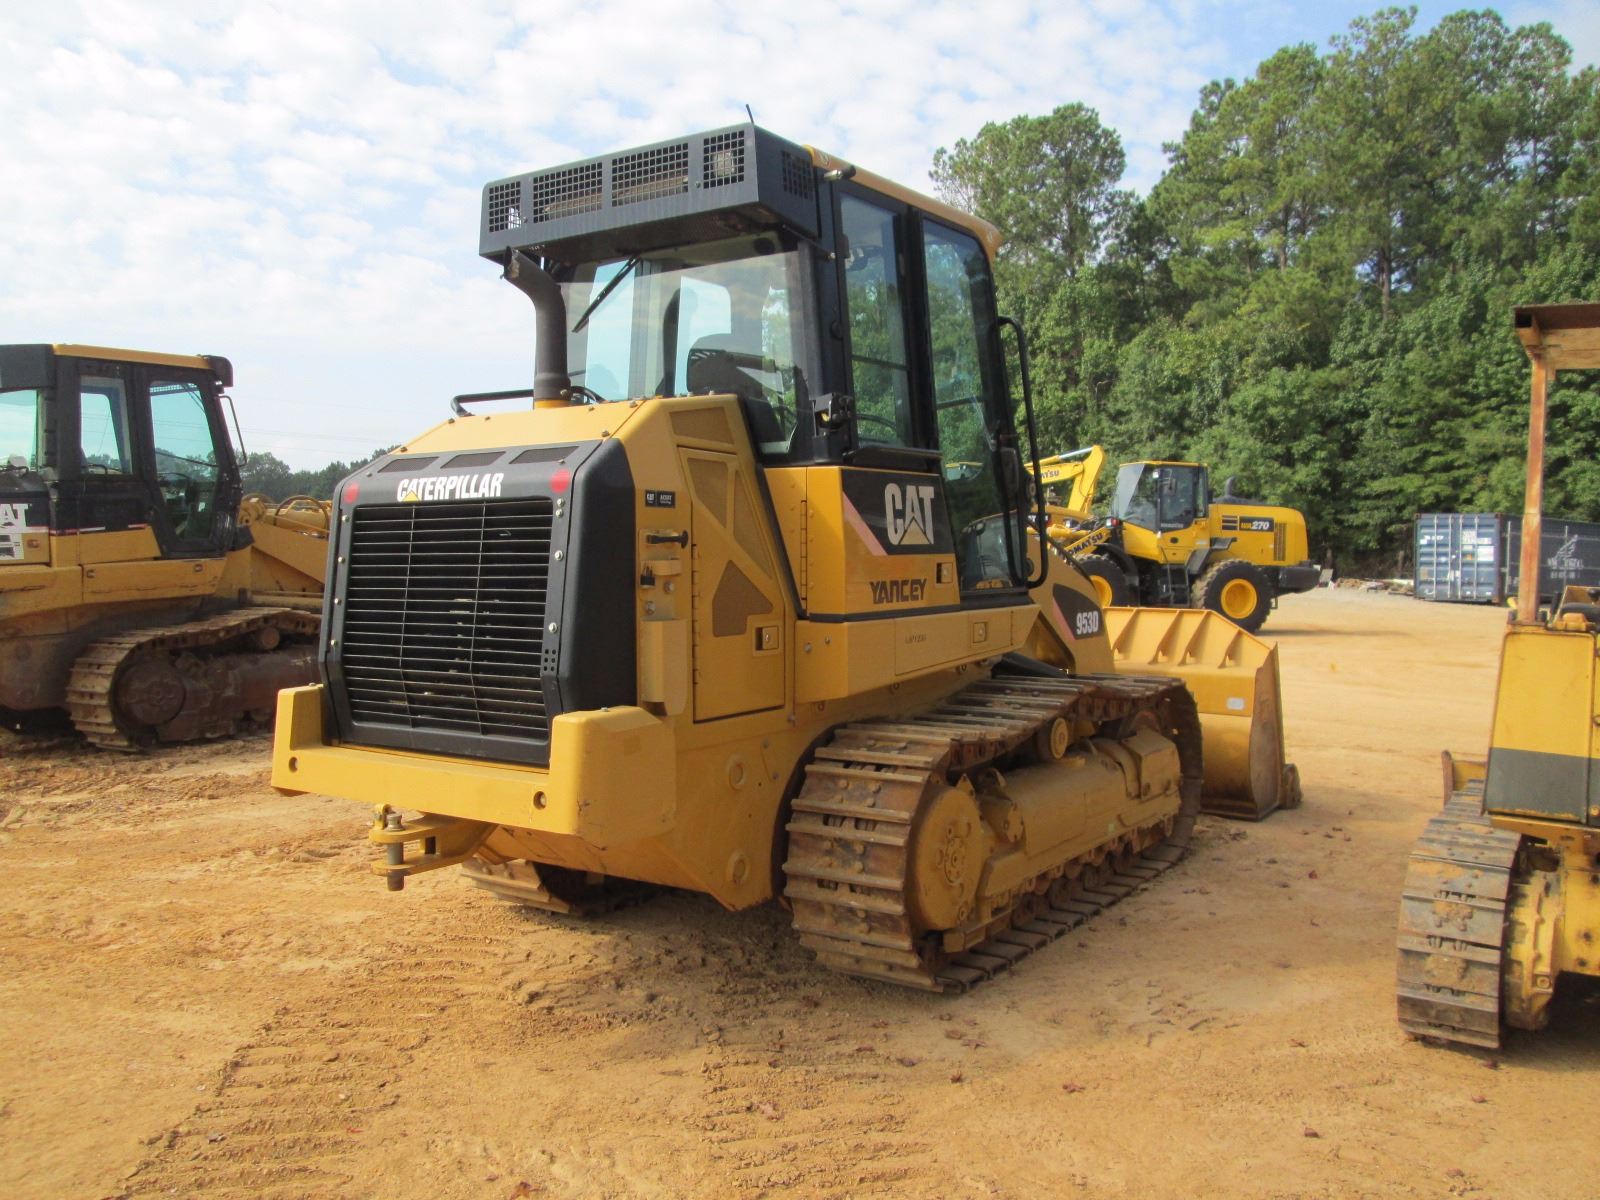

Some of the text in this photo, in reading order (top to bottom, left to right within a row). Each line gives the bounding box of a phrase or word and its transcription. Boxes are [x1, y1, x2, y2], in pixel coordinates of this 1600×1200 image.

[397, 473, 504, 502] CATERPILLAR
[0, 503, 29, 529] AT
[885, 483, 935, 545] CAT
[869, 578, 928, 604] YANCEY
[1076, 611, 1099, 635] 953D
